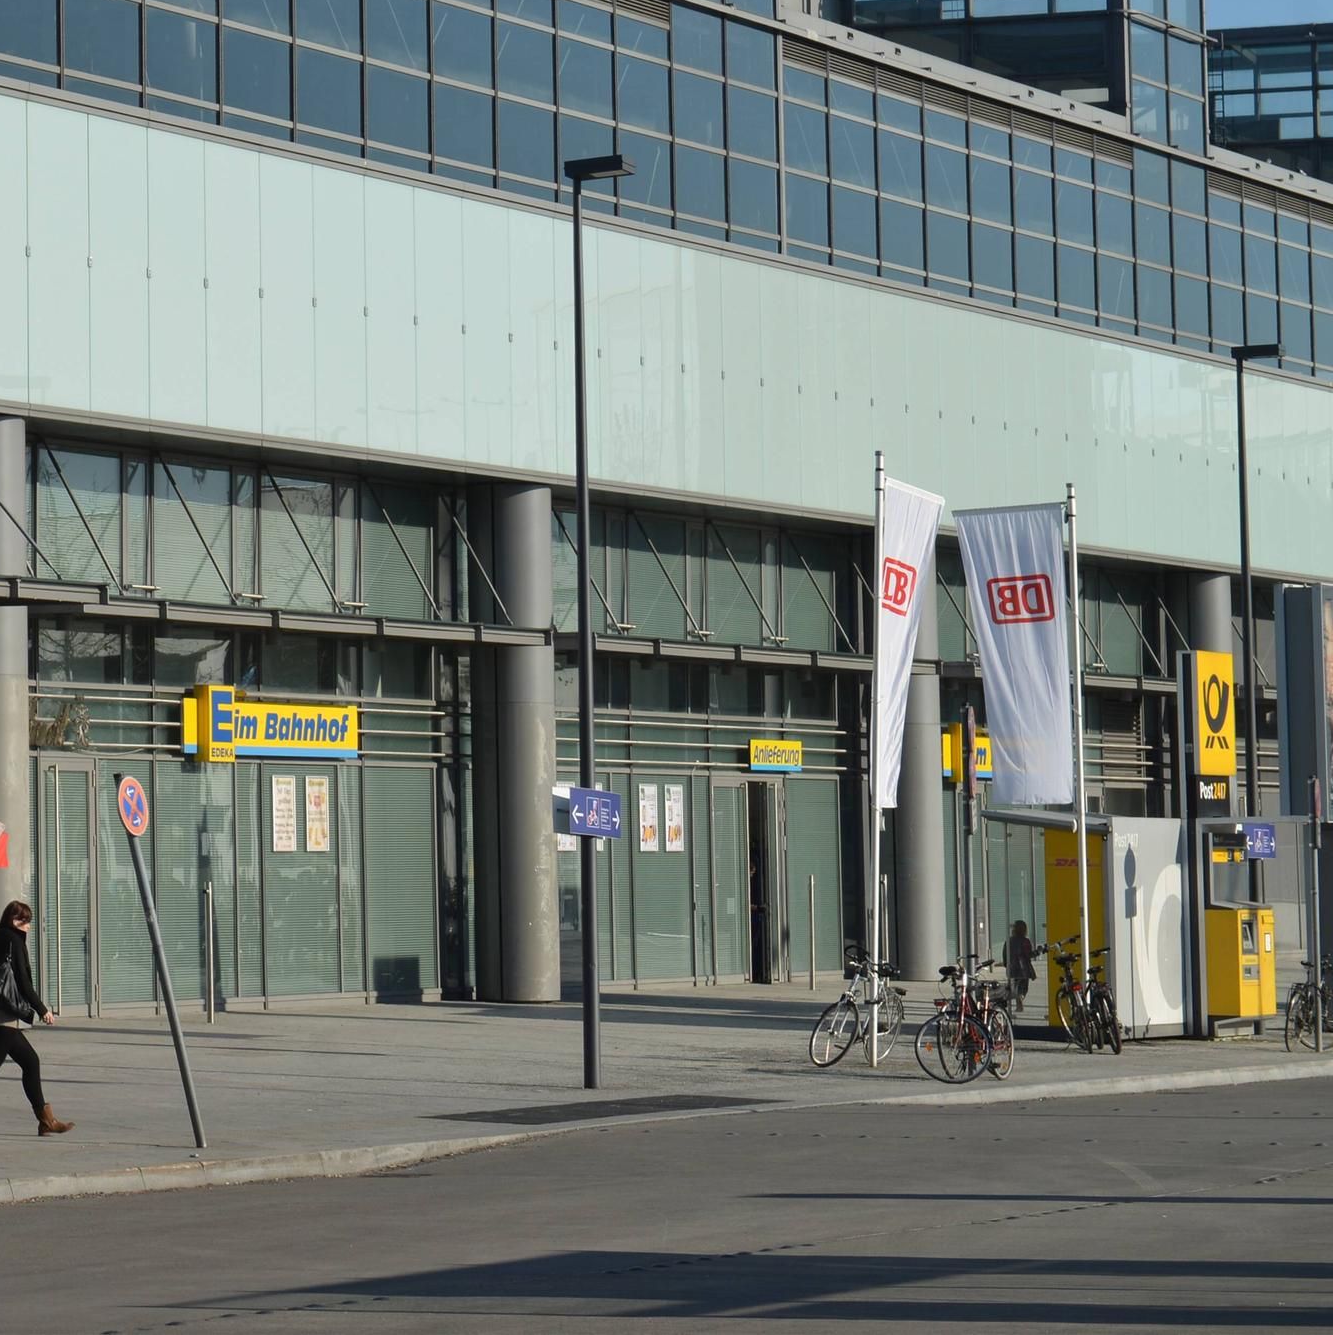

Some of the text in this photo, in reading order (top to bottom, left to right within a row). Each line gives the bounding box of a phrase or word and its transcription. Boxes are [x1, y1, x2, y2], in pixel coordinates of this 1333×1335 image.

[883, 567, 909, 606] DB
[264, 712, 350, 743] Bahnhof
[211, 747, 233, 758] EDEKA
[753, 745, 800, 767] Anlieferung
